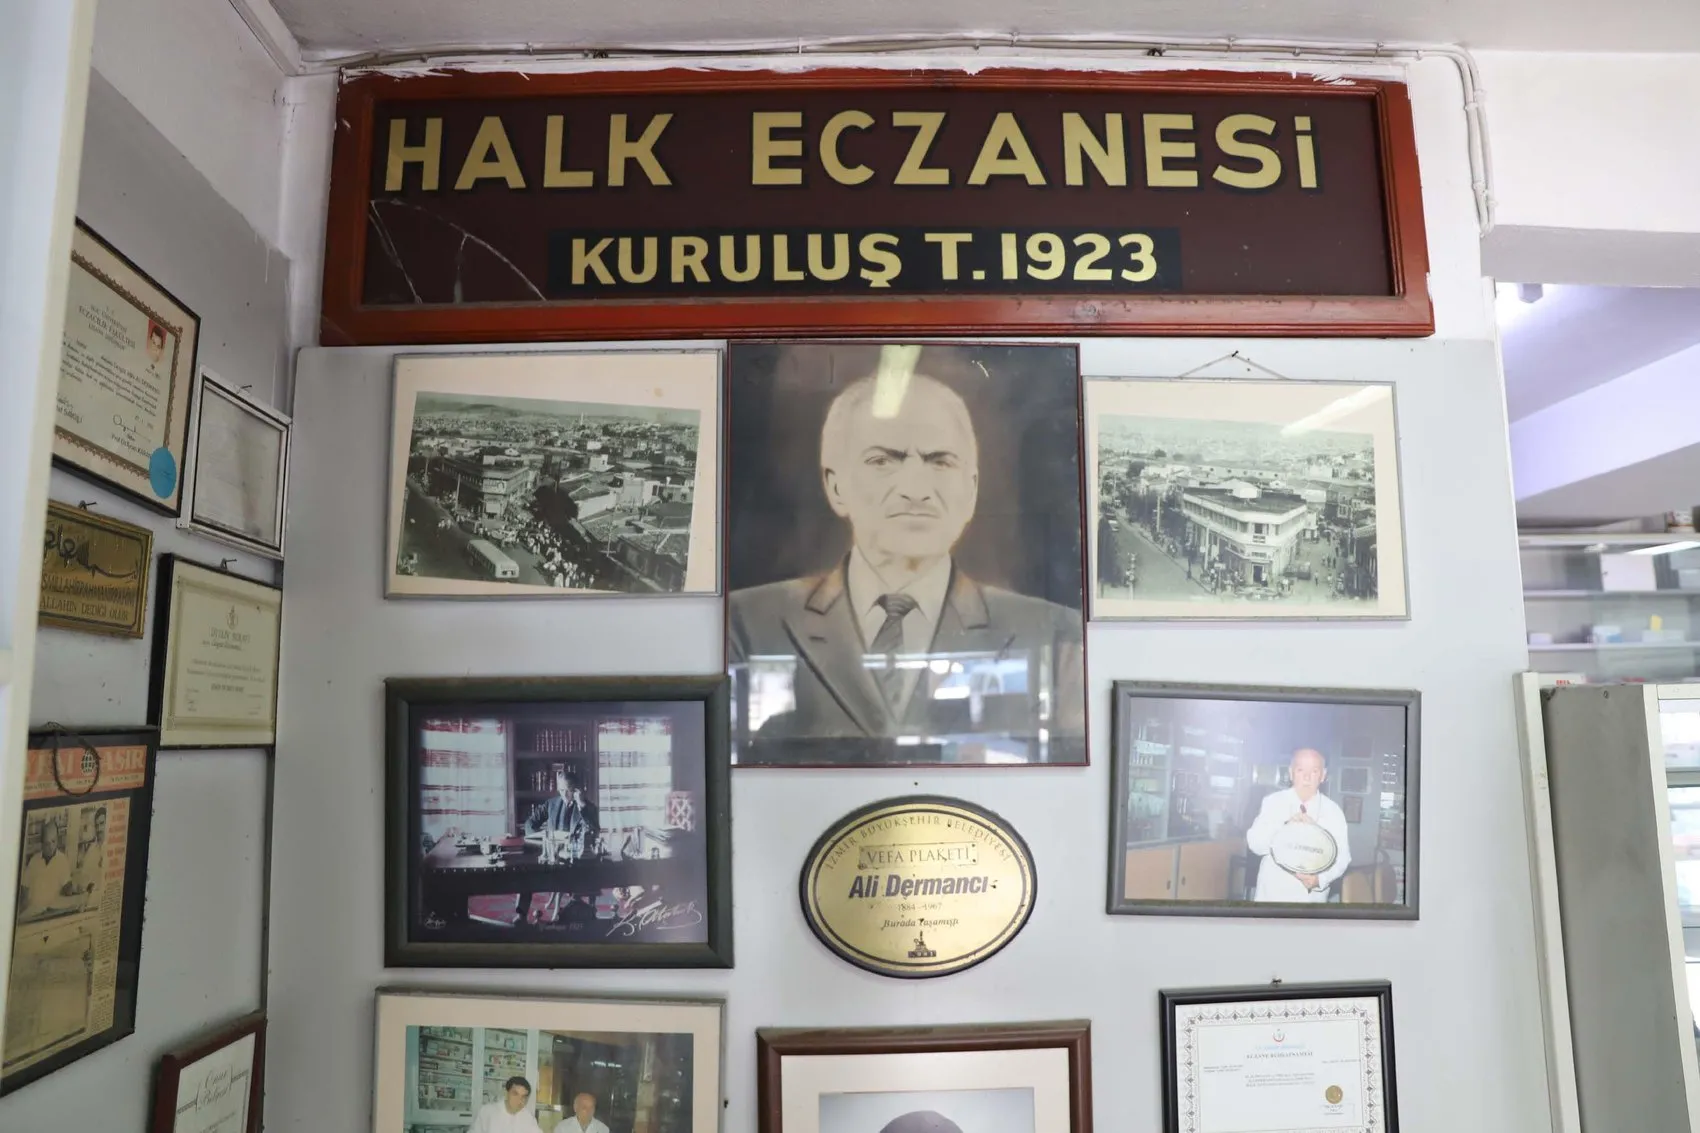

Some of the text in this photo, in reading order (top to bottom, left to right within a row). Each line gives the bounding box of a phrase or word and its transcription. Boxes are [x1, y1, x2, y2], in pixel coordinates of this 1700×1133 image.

[384, 113, 675, 192] HALK
[571, 233, 902, 288] KURULUŞ
[867, 850, 904, 863] VEFA
[848, 873, 989, 899] Ali Dermancı
[883, 919, 916, 928] Burada
